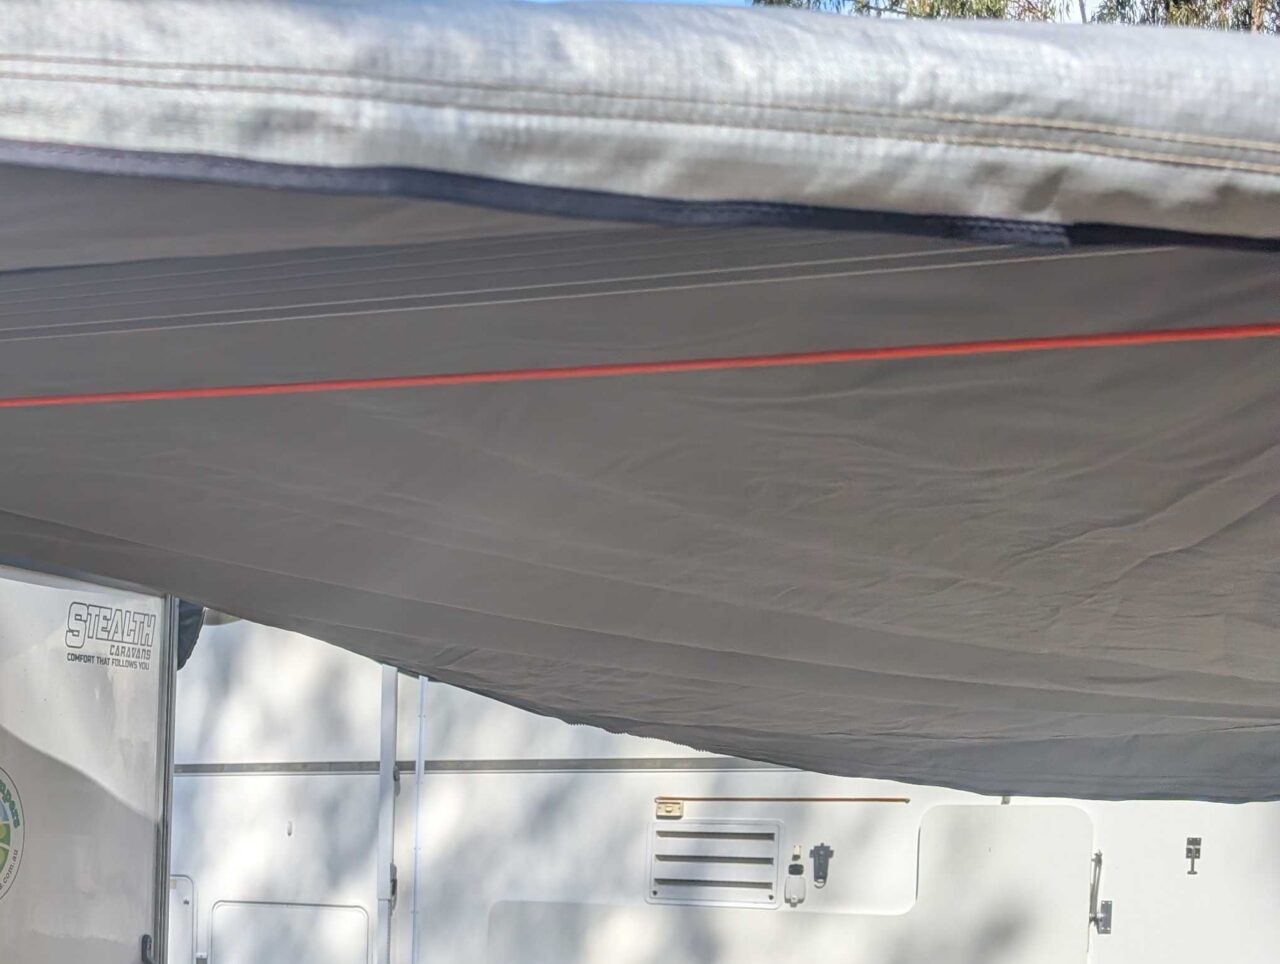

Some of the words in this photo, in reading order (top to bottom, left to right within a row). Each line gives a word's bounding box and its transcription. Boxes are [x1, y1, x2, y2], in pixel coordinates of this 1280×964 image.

[65, 601, 156, 649] STEALTH
[67, 652, 95, 664] COMFORT
[96, 656, 110, 666] THAT
[111, 658, 138, 670] FOLLOWS
[138, 661, 150, 671] YOU
[109, 644, 151, 660] CARAVANS
